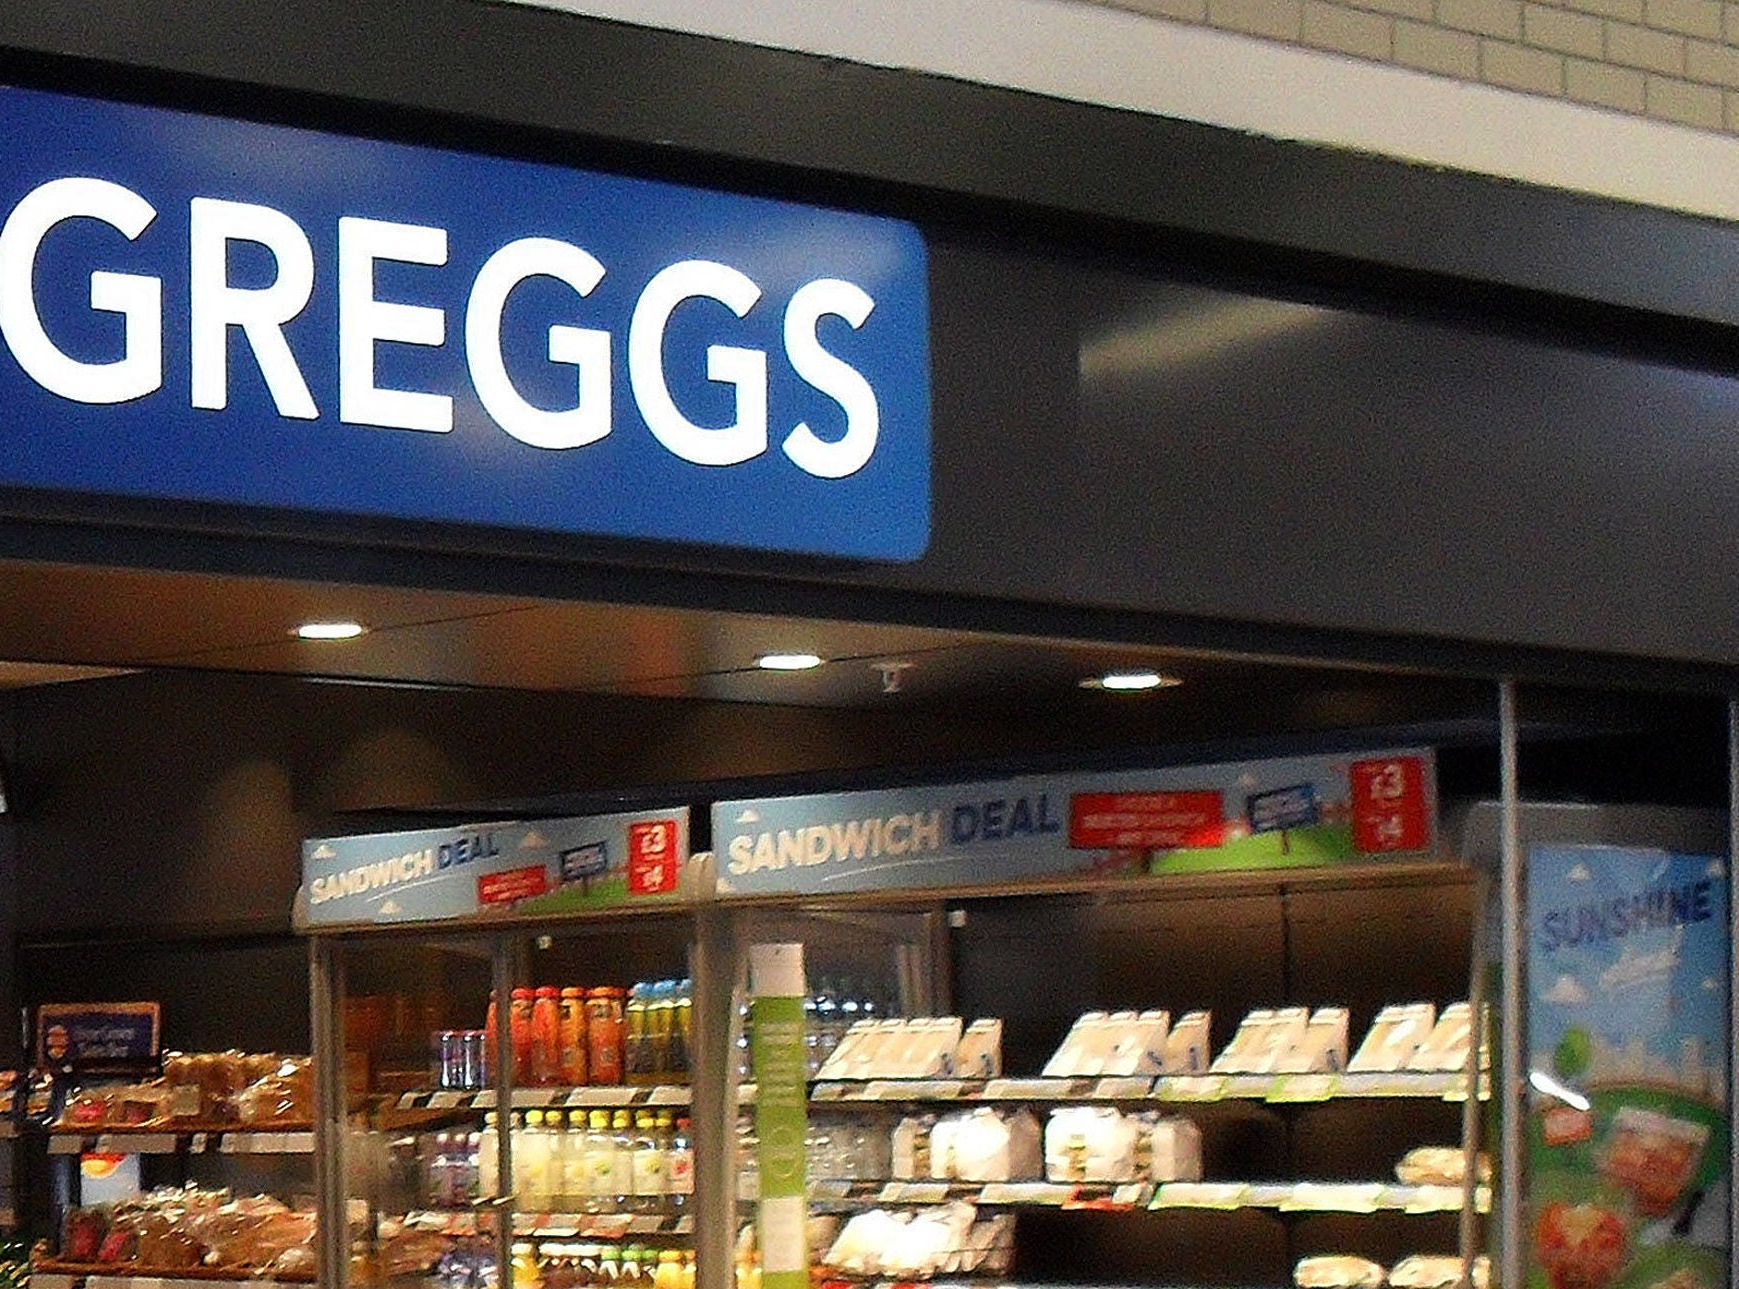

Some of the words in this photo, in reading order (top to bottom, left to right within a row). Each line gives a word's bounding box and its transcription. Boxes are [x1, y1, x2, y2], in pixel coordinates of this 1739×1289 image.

[310, 848, 435, 905] SANDWICH
[437, 832, 500, 871] DEAL
[727, 806, 942, 878] SANDWICH
[949, 796, 1061, 847] DEAL
